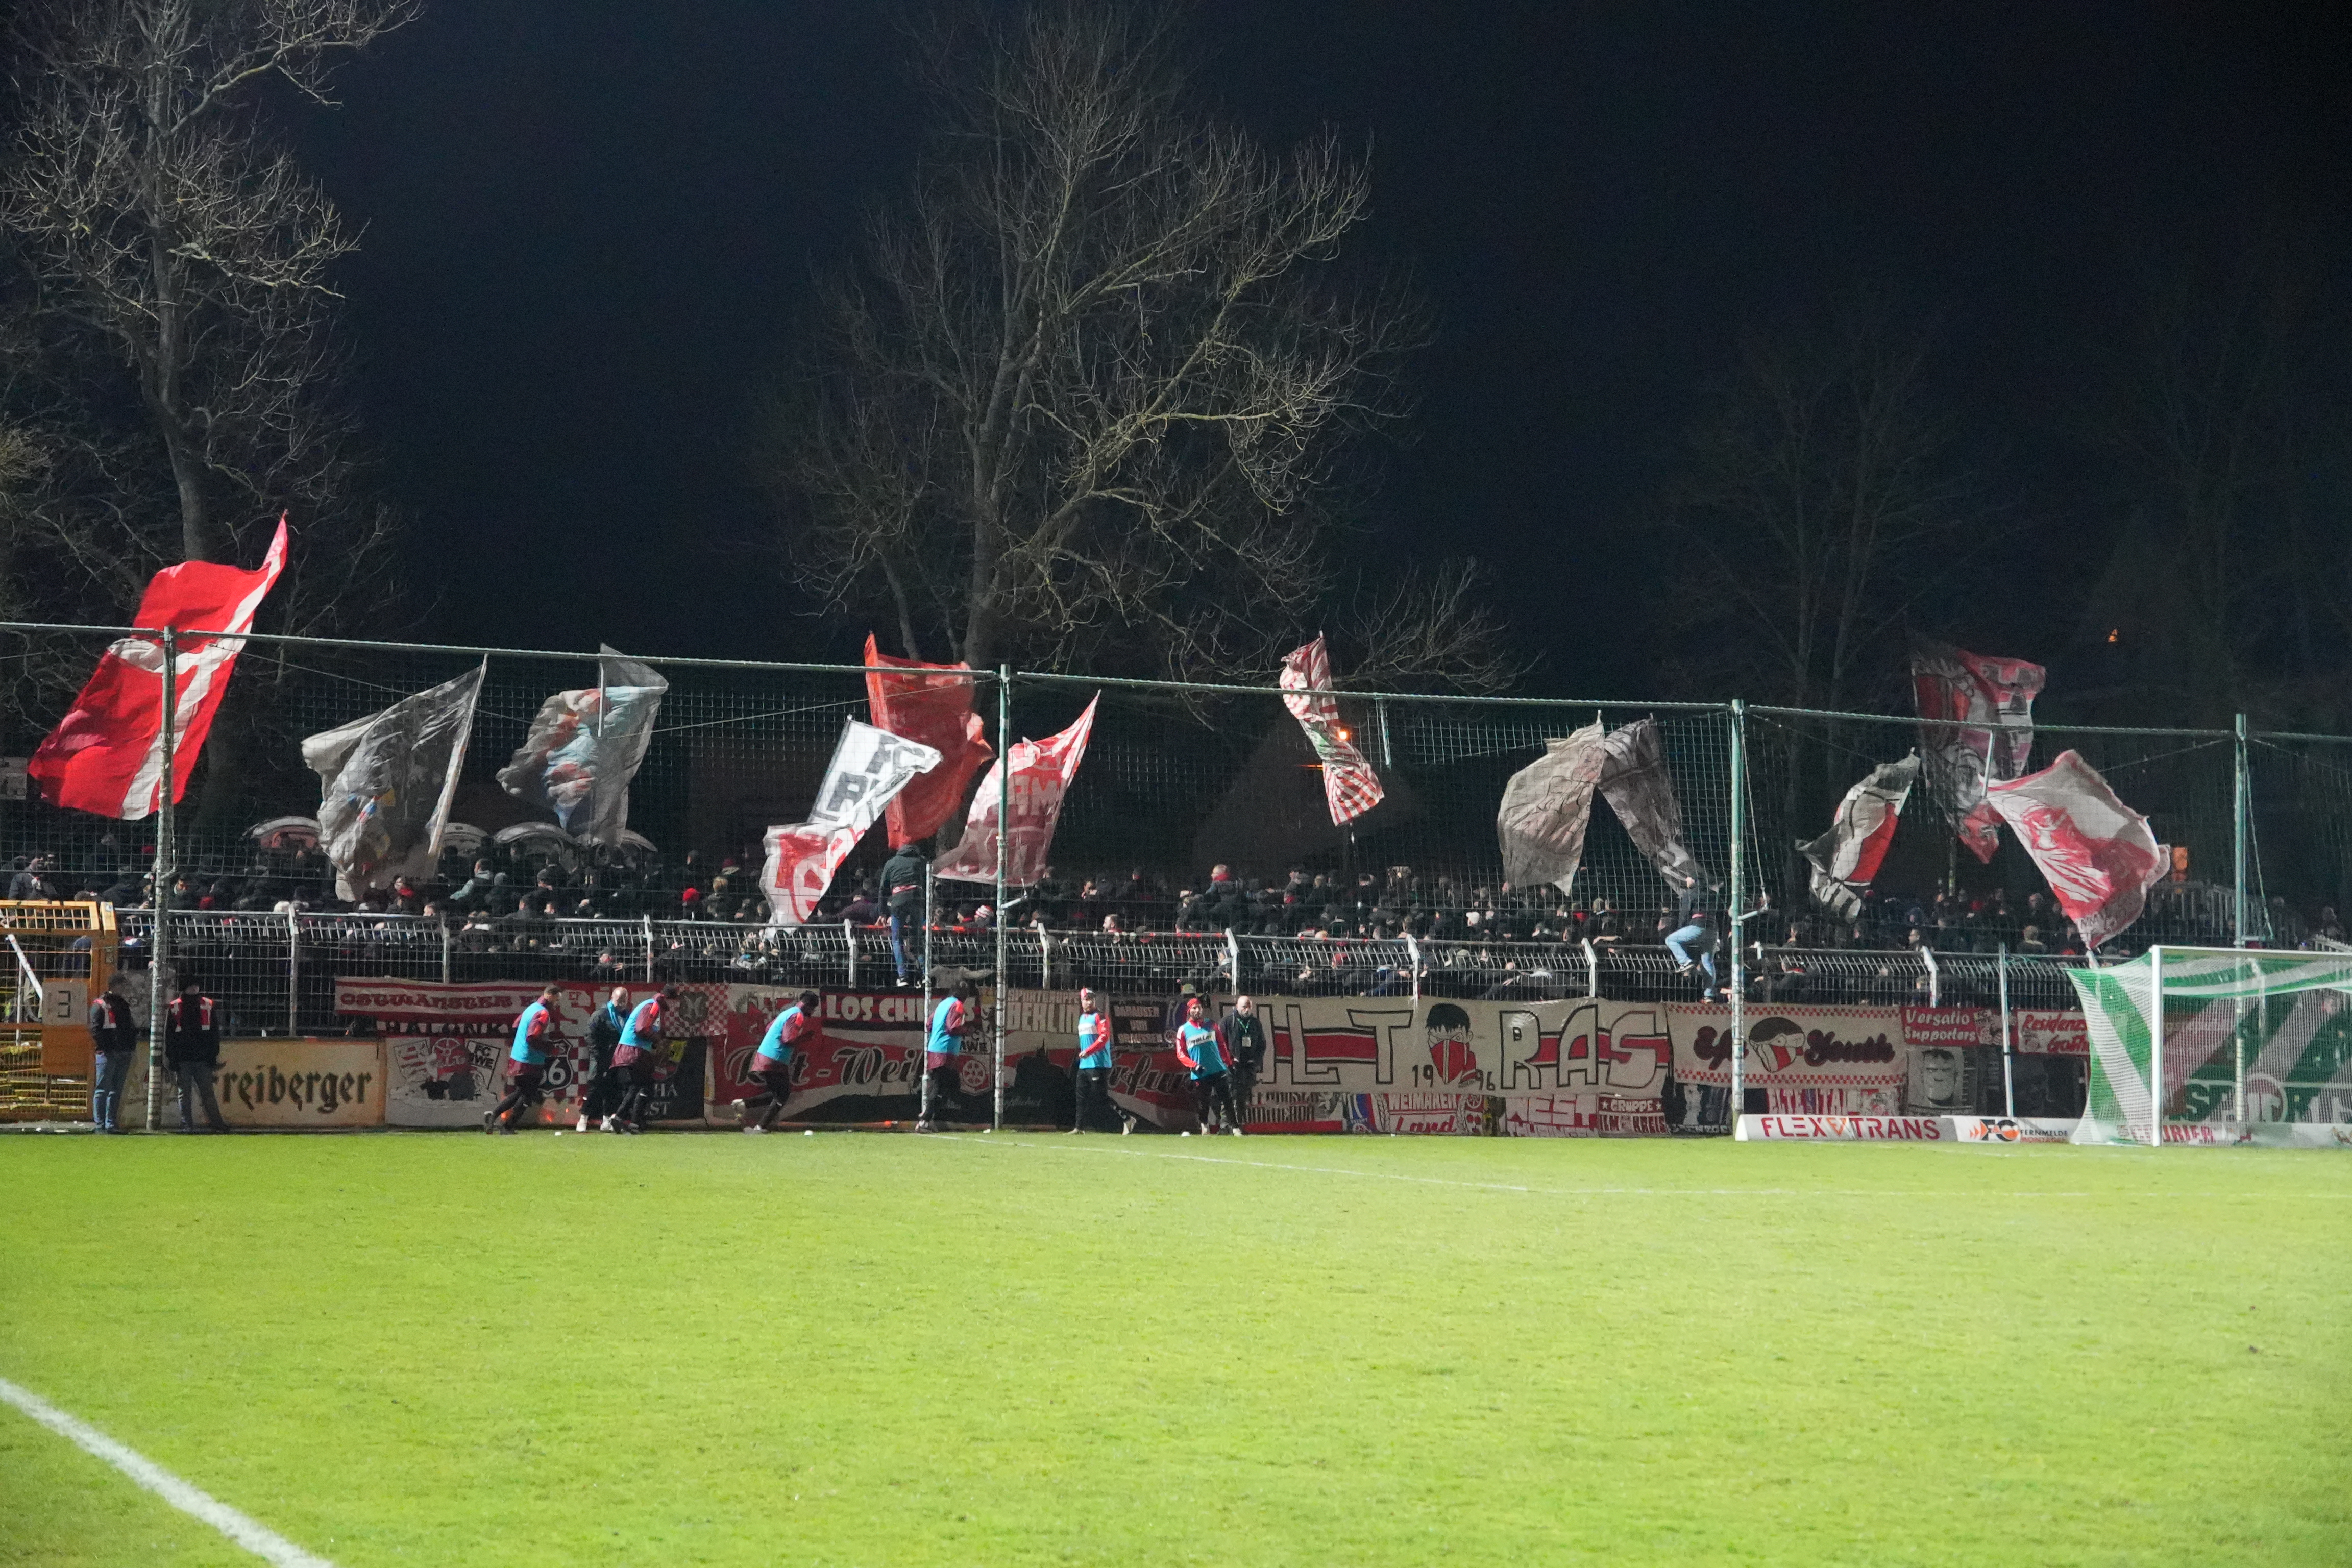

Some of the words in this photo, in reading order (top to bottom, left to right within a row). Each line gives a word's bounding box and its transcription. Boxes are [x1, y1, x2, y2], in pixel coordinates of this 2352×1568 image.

[57, 990, 71, 1018] 3
[826, 994, 873, 1021] LOS
[879, 996, 976, 1022] CHIS
[1006, 1002, 1079, 1033] BERLIN
[1904, 1027, 1976, 1042] Supporters
[1412, 1064, 1434, 1088] 19
[1610, 1099, 1654, 1112] GRUPPE
[1394, 1116, 1457, 1133] Land
